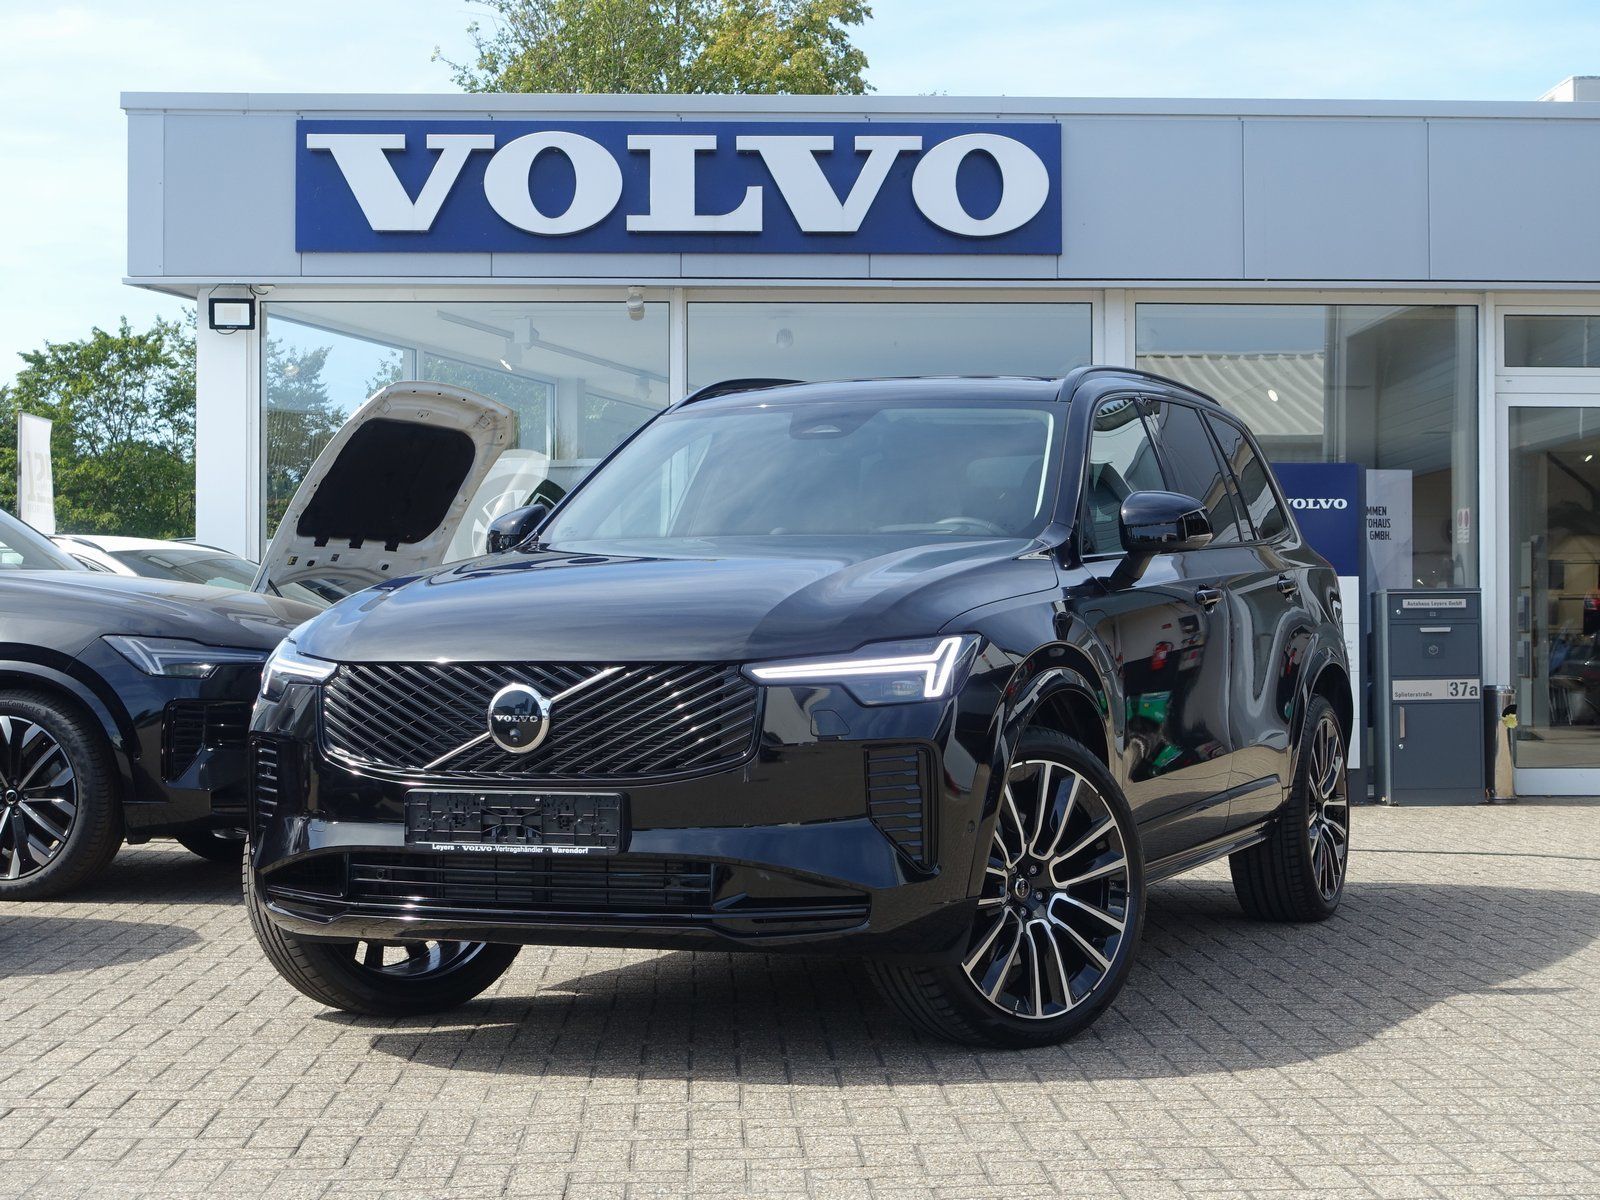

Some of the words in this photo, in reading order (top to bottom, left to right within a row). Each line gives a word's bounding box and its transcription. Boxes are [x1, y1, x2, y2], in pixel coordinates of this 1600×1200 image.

[305, 130, 1050, 236] VOLVO
[1449, 681, 1478, 697] 37a
[494, 714, 539, 723] VOLVO
[432, 843, 455, 851] Leyers
